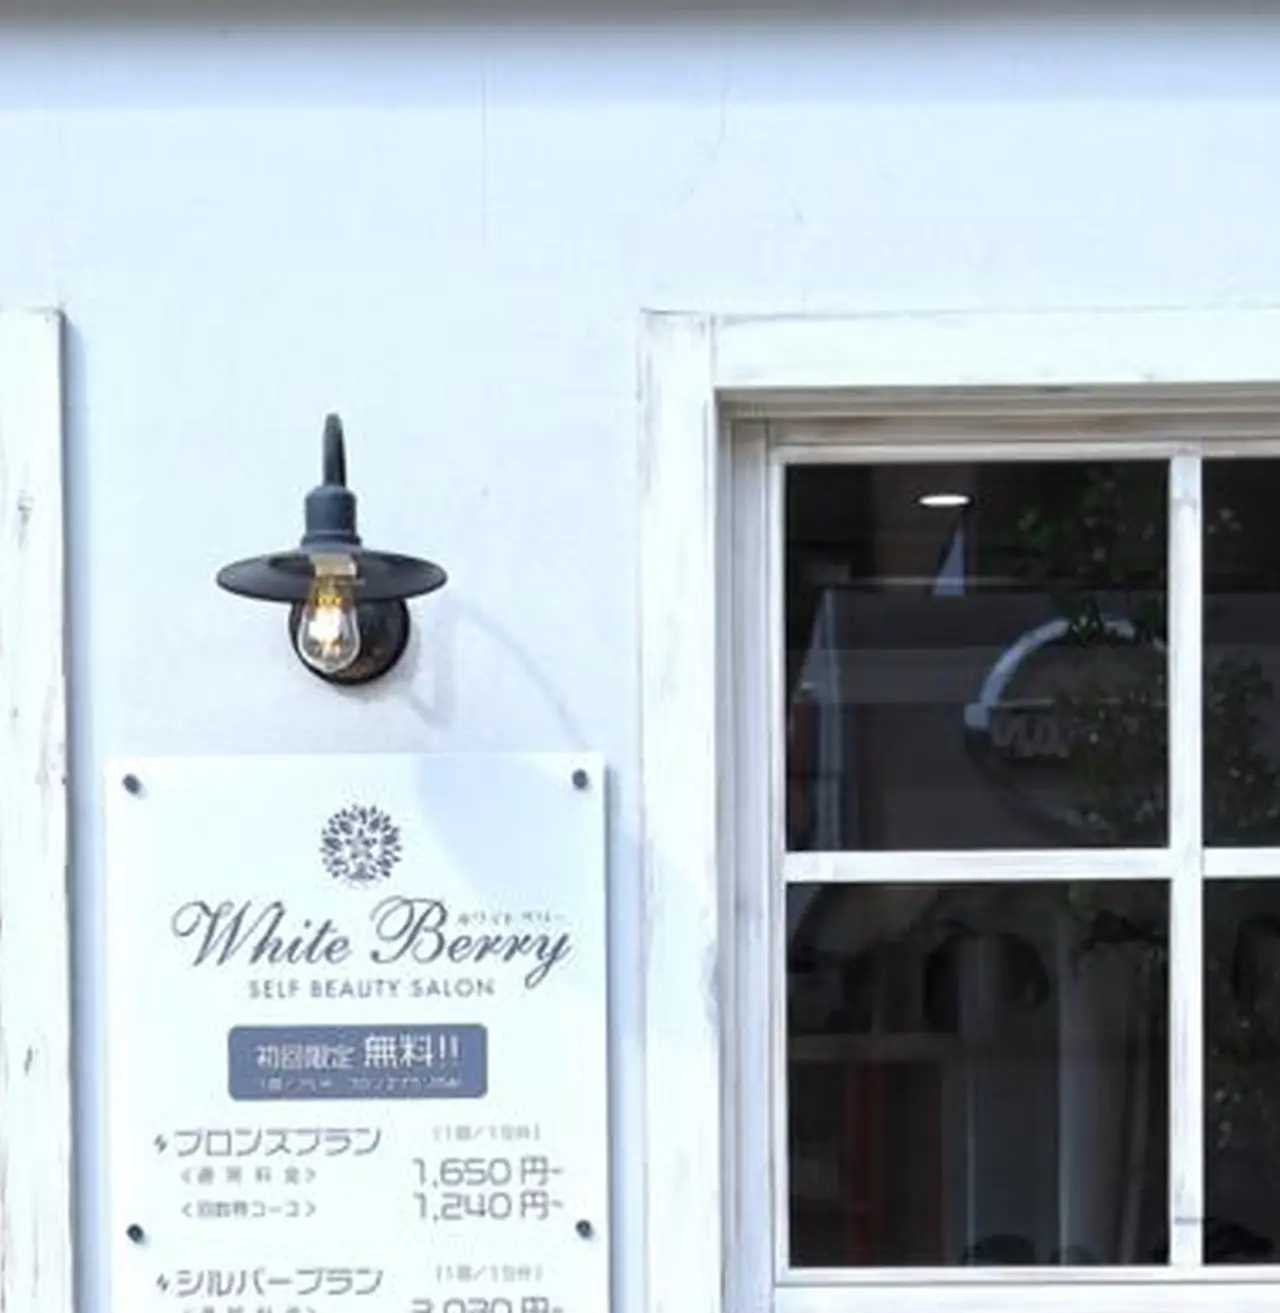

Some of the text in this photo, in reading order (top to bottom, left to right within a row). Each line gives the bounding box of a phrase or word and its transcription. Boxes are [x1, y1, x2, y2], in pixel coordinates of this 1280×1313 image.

[171, 895, 573, 990] White Berry
[248, 977, 496, 1000] SELF BEAUTY SALON
[255, 1032, 459, 1073] 初回限定 無料!!
